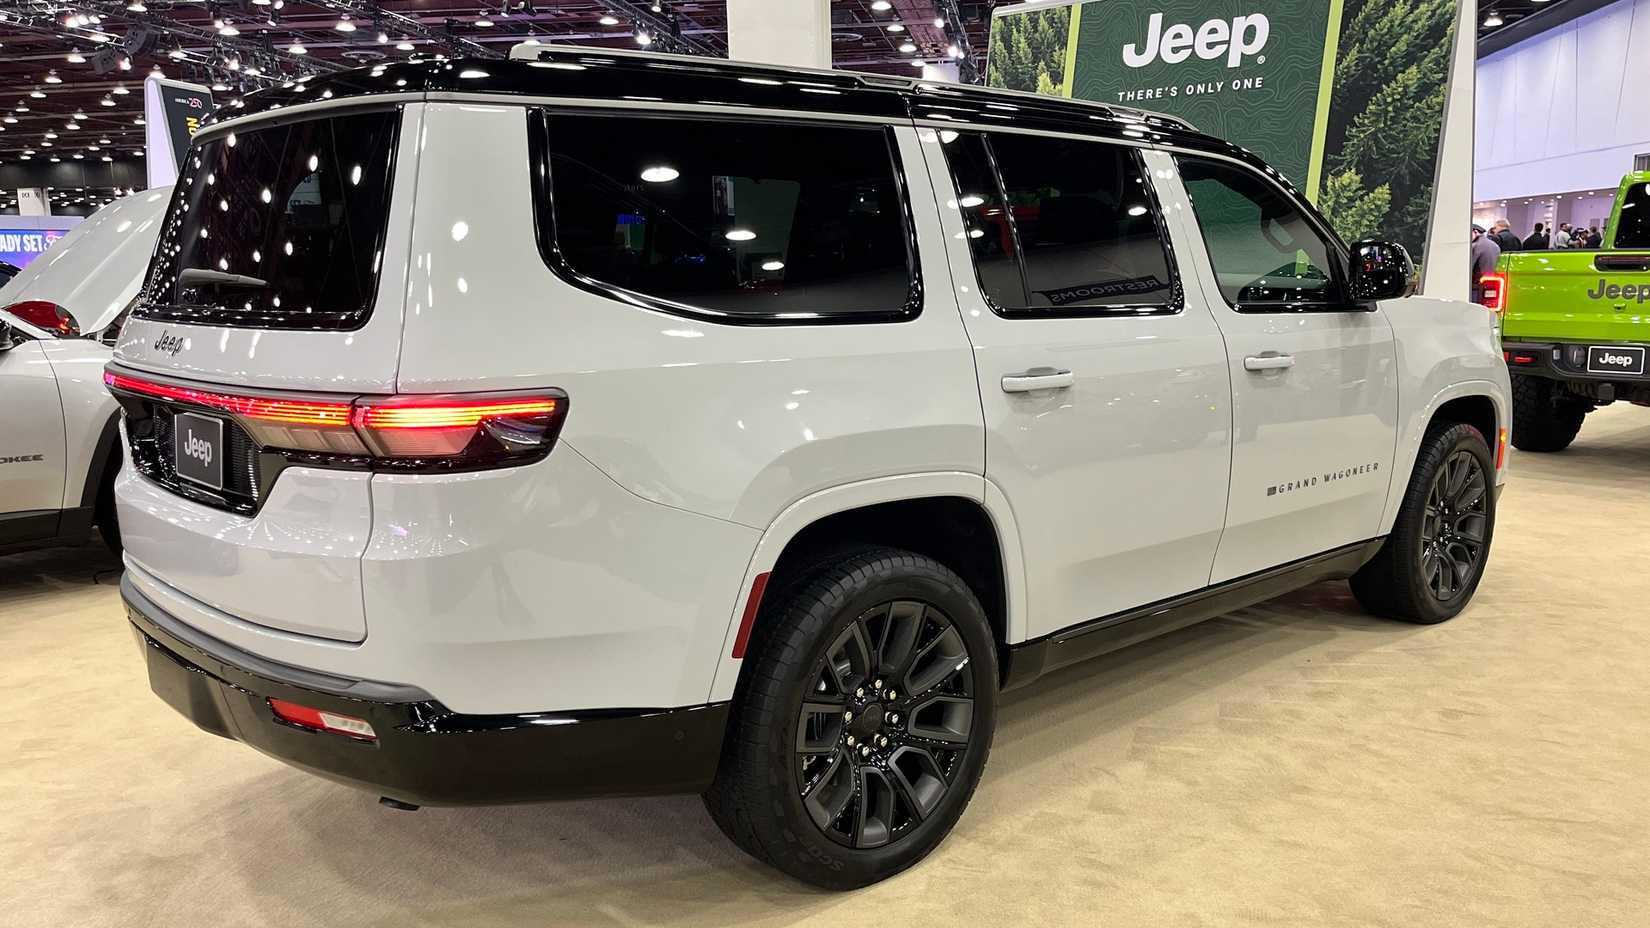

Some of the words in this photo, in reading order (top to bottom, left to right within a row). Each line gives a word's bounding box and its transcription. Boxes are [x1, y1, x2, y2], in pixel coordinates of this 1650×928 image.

[1123, 13, 1270, 68] Jeep
[1118, 86, 1178, 102] THERE'S
[1186, 82, 1224, 95] ONLY
[1232, 77, 1264, 90] ONE
[23, 234, 42, 252] SET
[1588, 279, 1650, 304] Jeep
[154, 330, 183, 356] Jeep
[1599, 352, 1633, 367] Jeep
[184, 429, 212, 467] Jeep
[1279, 477, 1317, 493] GRAND
[1323, 462, 1379, 482] WAGONEER
